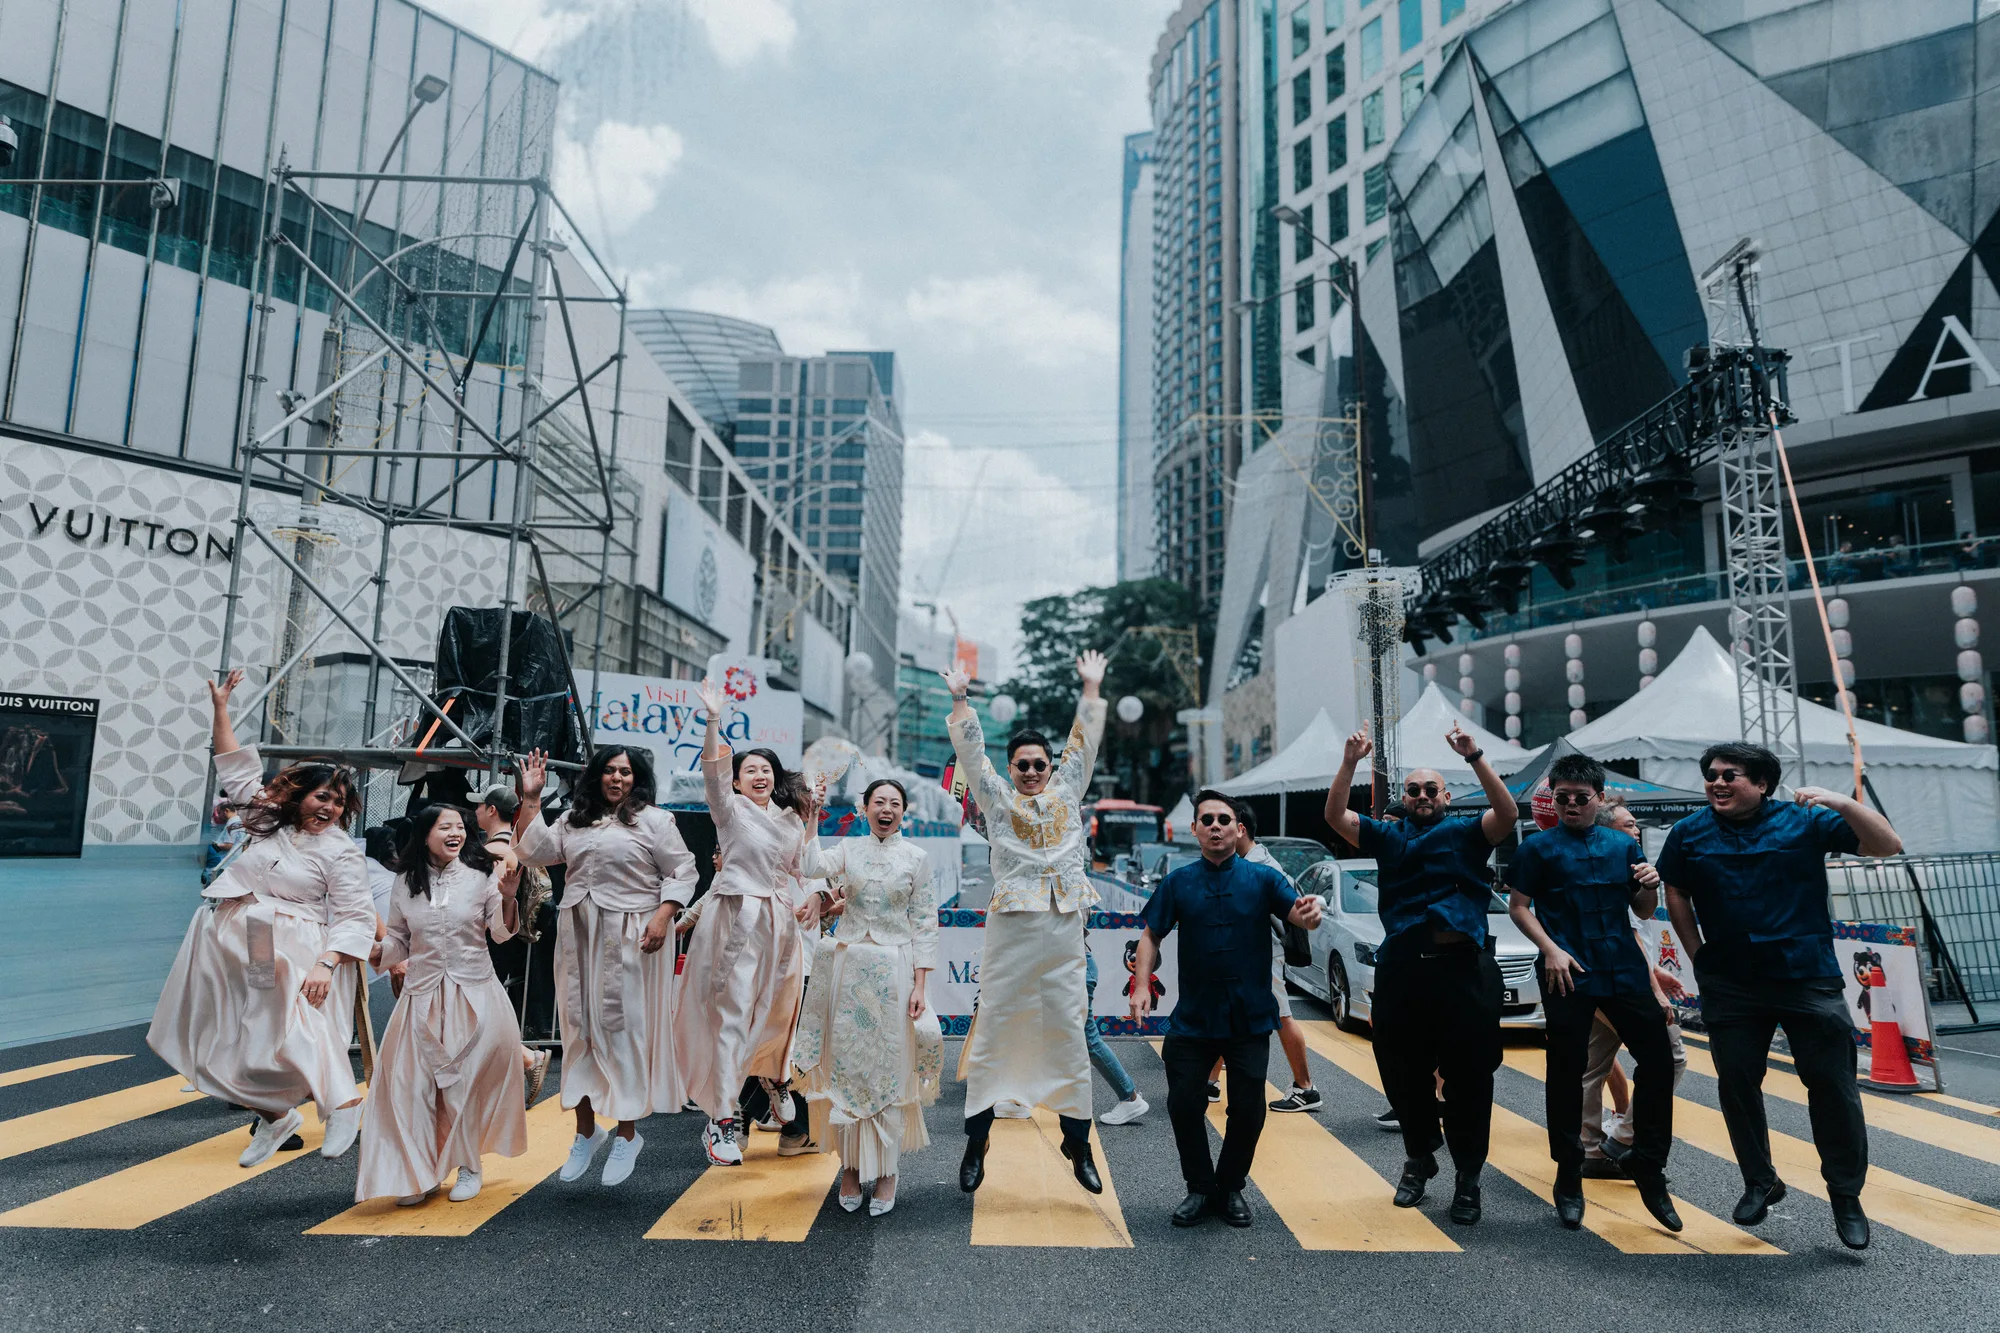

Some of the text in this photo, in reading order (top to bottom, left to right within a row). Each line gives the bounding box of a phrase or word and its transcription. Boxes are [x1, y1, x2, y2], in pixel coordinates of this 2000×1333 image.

[29, 502, 235, 563] VUITTON
[645, 685, 687, 704] Visit
[28, 698, 94, 712] VUITTON
[568, 687, 751, 745] alaysa
[1661, 804, 1685, 812] Unite
